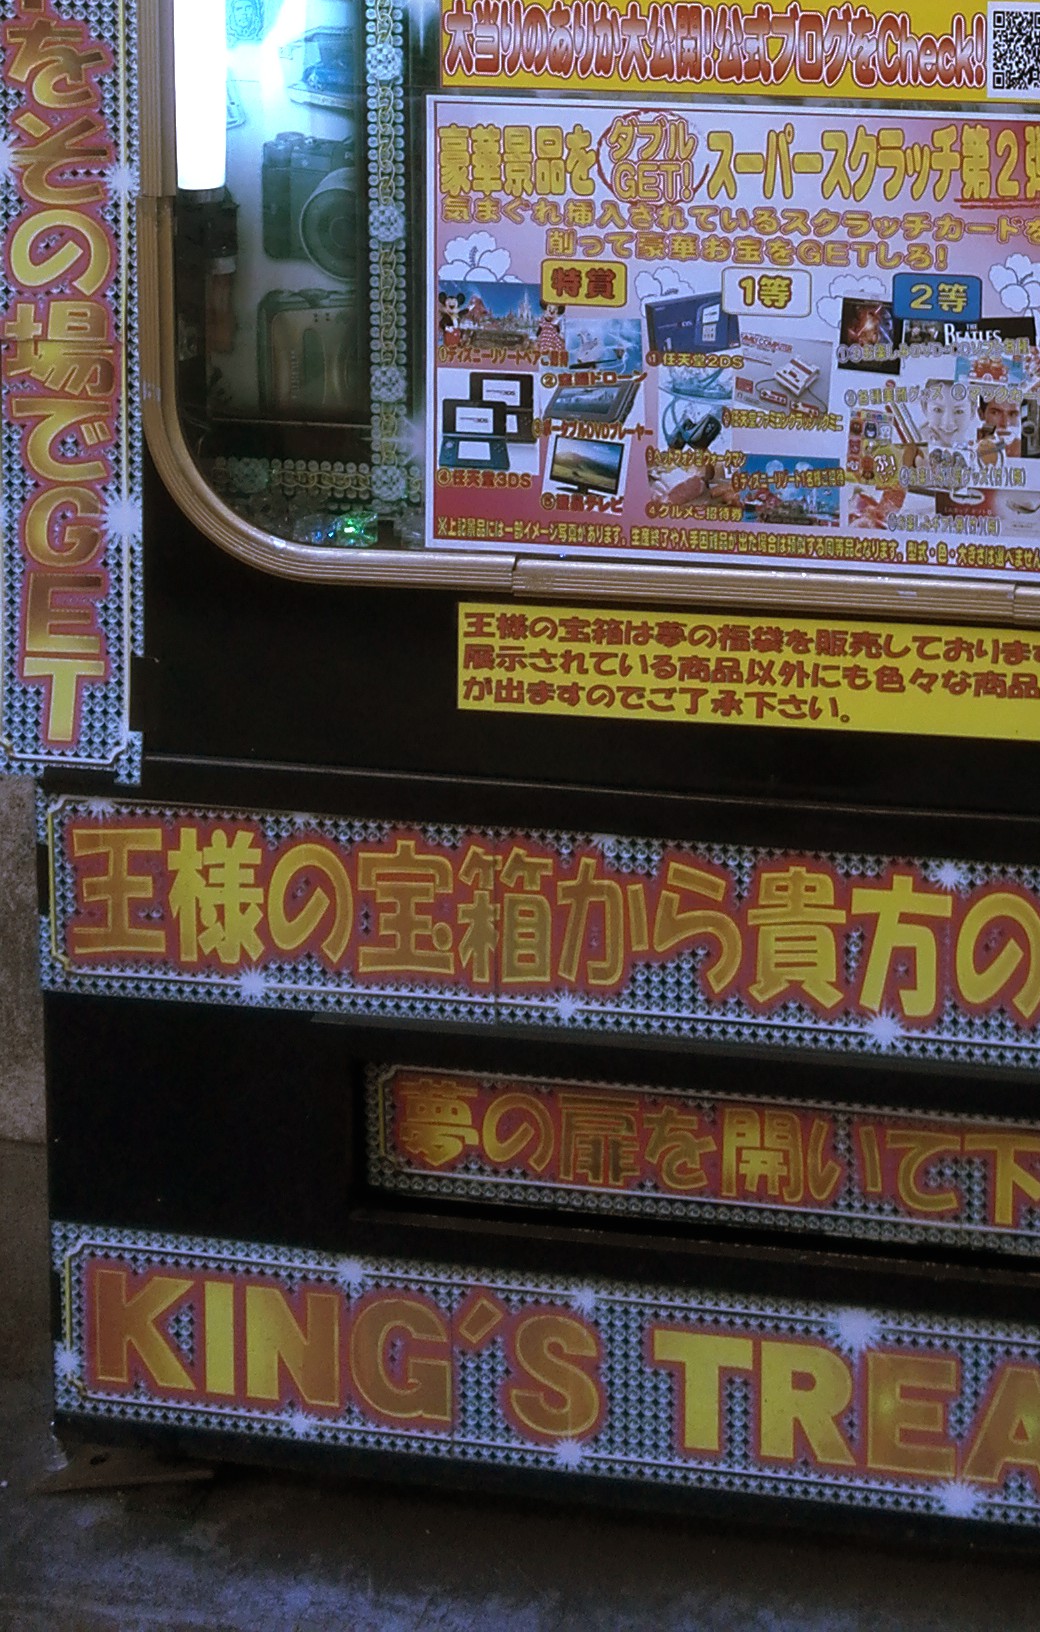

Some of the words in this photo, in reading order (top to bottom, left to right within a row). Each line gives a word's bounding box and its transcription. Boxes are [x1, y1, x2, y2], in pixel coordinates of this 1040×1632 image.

[438, 123, 597, 197] 豪華景品を
[607, 115, 698, 162] ダブル
[612, 159, 695, 203] GET!
[546, 226, 950, 272] 削って豪華お宝をGETしろ!
[550, 266, 618, 299] 特賞
[738, 273, 794, 309] 1等
[908, 282, 970, 313] 2等
[462, 675, 852, 724] が出ますのでご了承下さい。
[93, 1269, 602, 1436] KING'S
